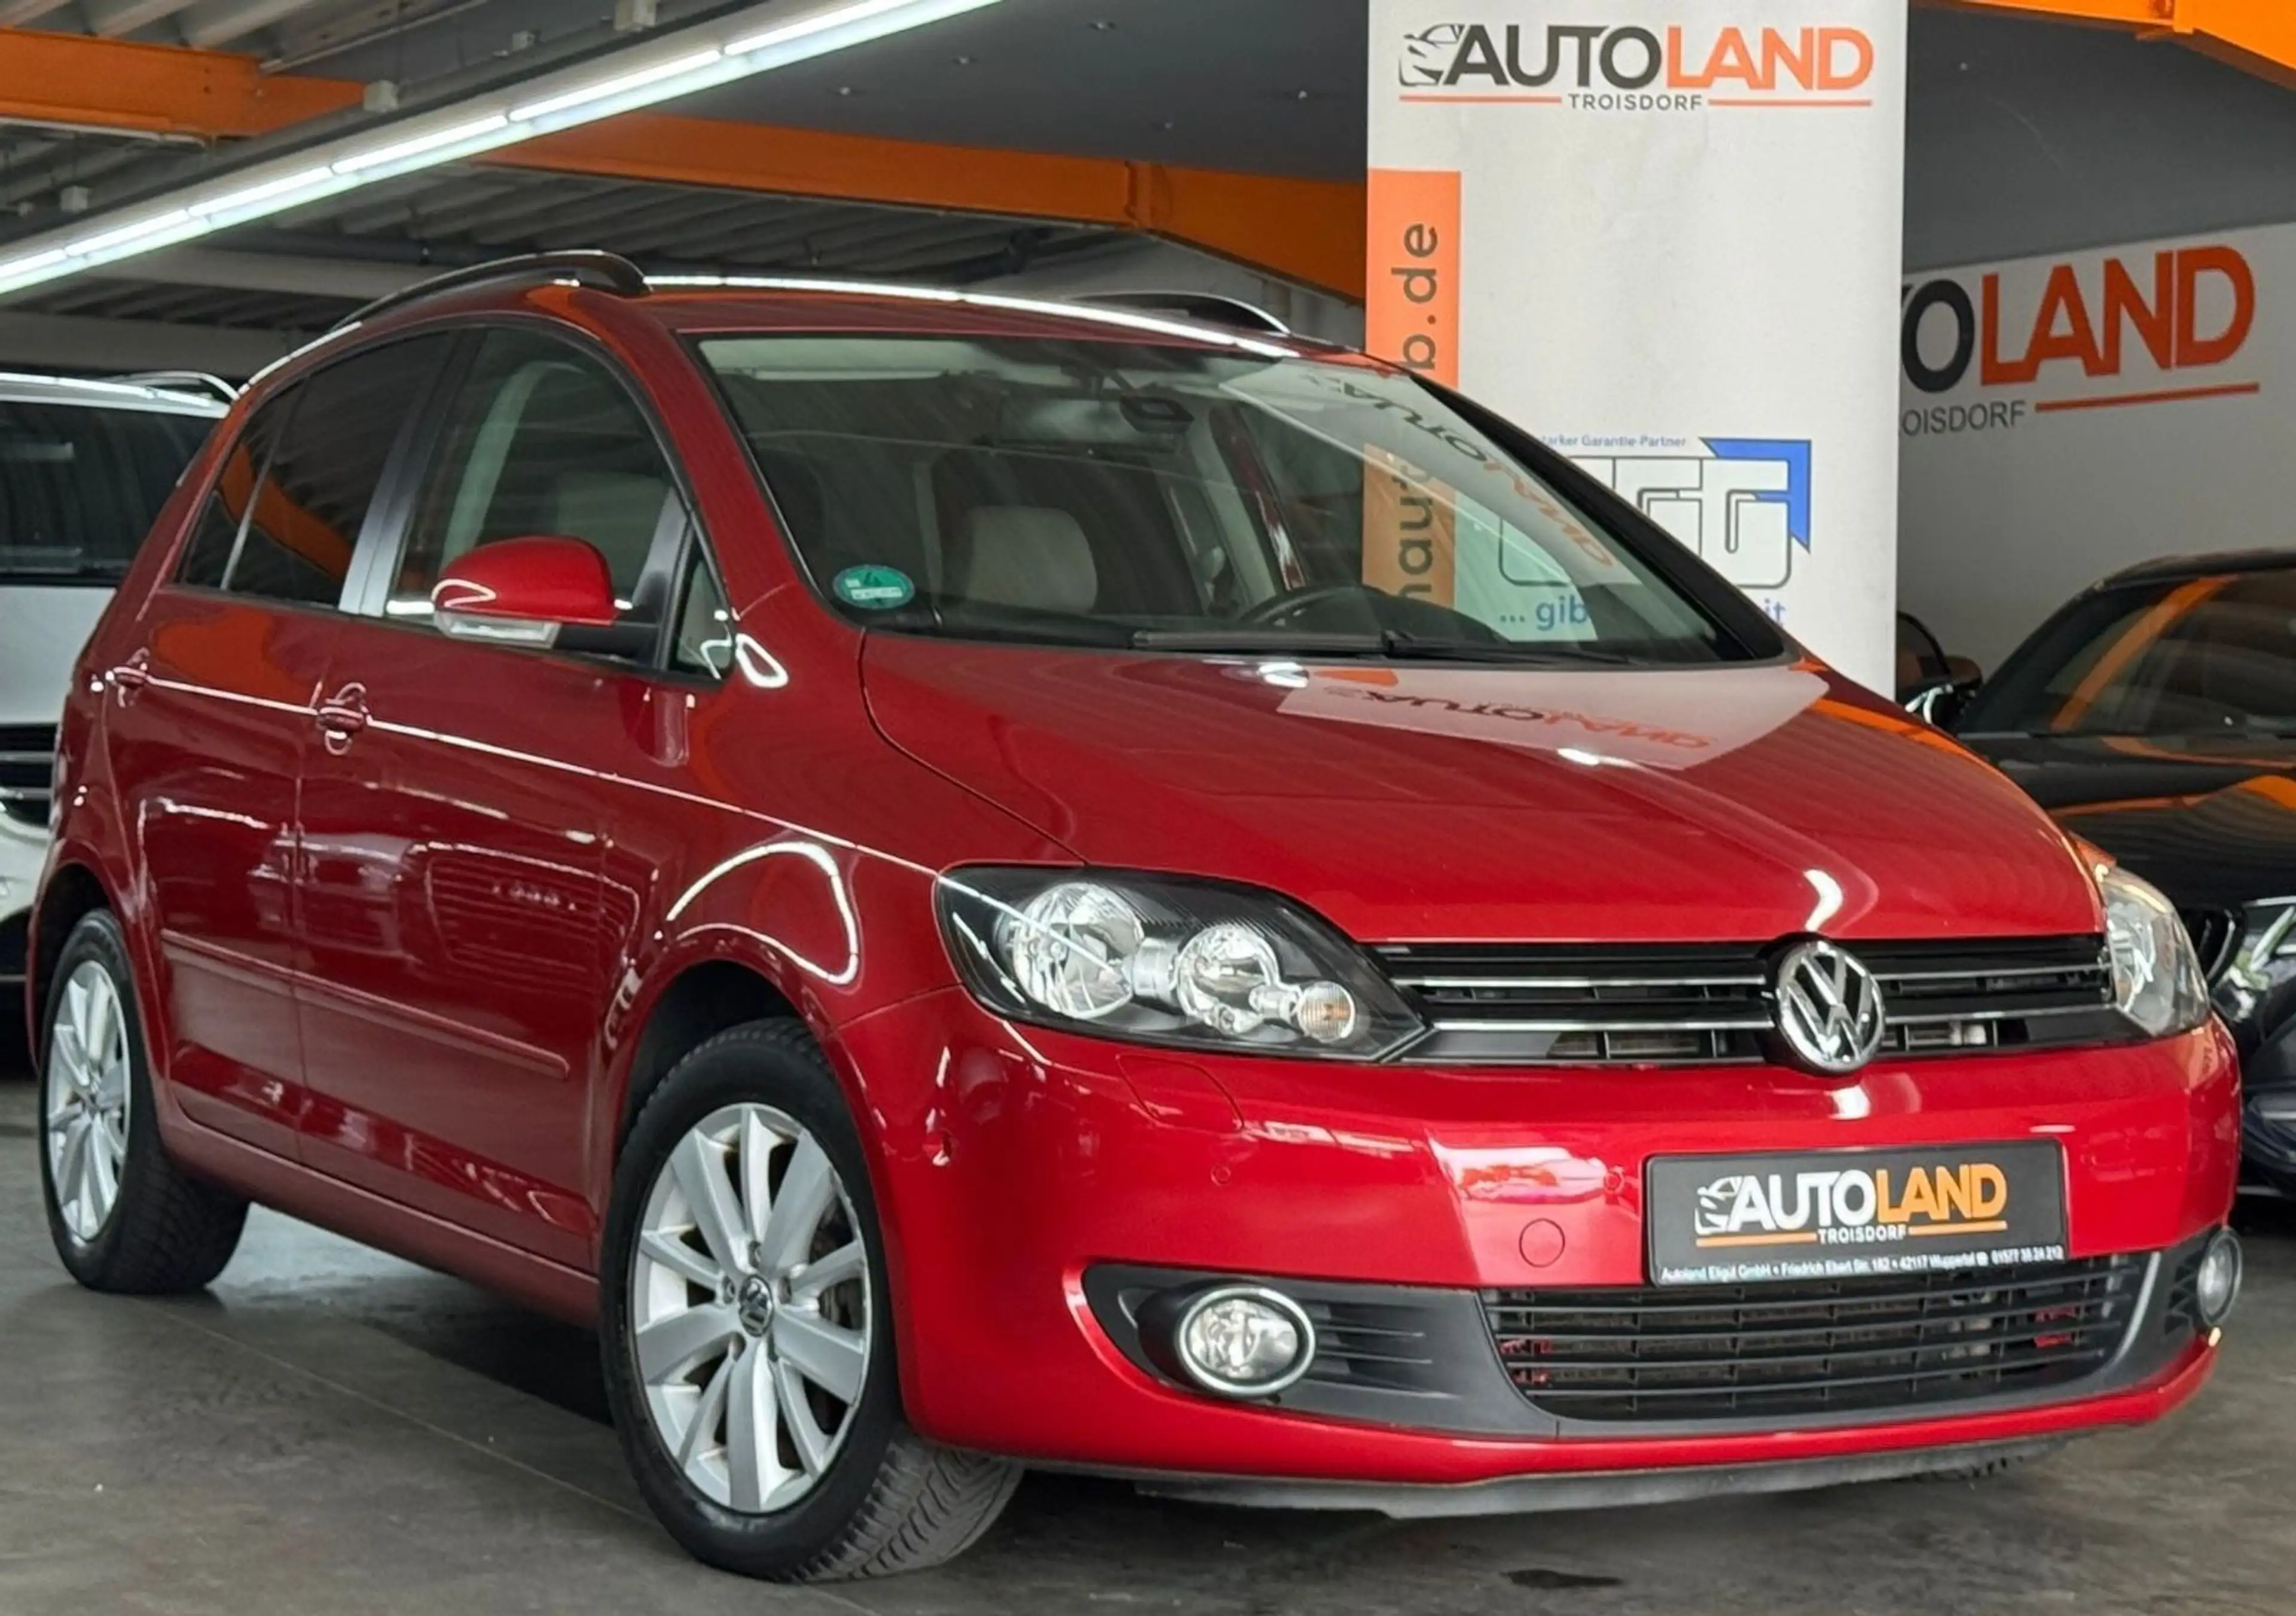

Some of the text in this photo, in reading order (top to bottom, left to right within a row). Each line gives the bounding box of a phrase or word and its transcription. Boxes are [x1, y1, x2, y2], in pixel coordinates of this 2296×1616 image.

[1443, 24, 1874, 90] AUTOLAND
[1568, 93, 1703, 112] TROISDORF
[1900, 244, 2256, 393] OLAND
[1899, 400, 2026, 436] OISDORF
[1727, 1163, 2007, 1232] AUTOLAND
[1818, 1225, 1906, 1245] TROISDORF
